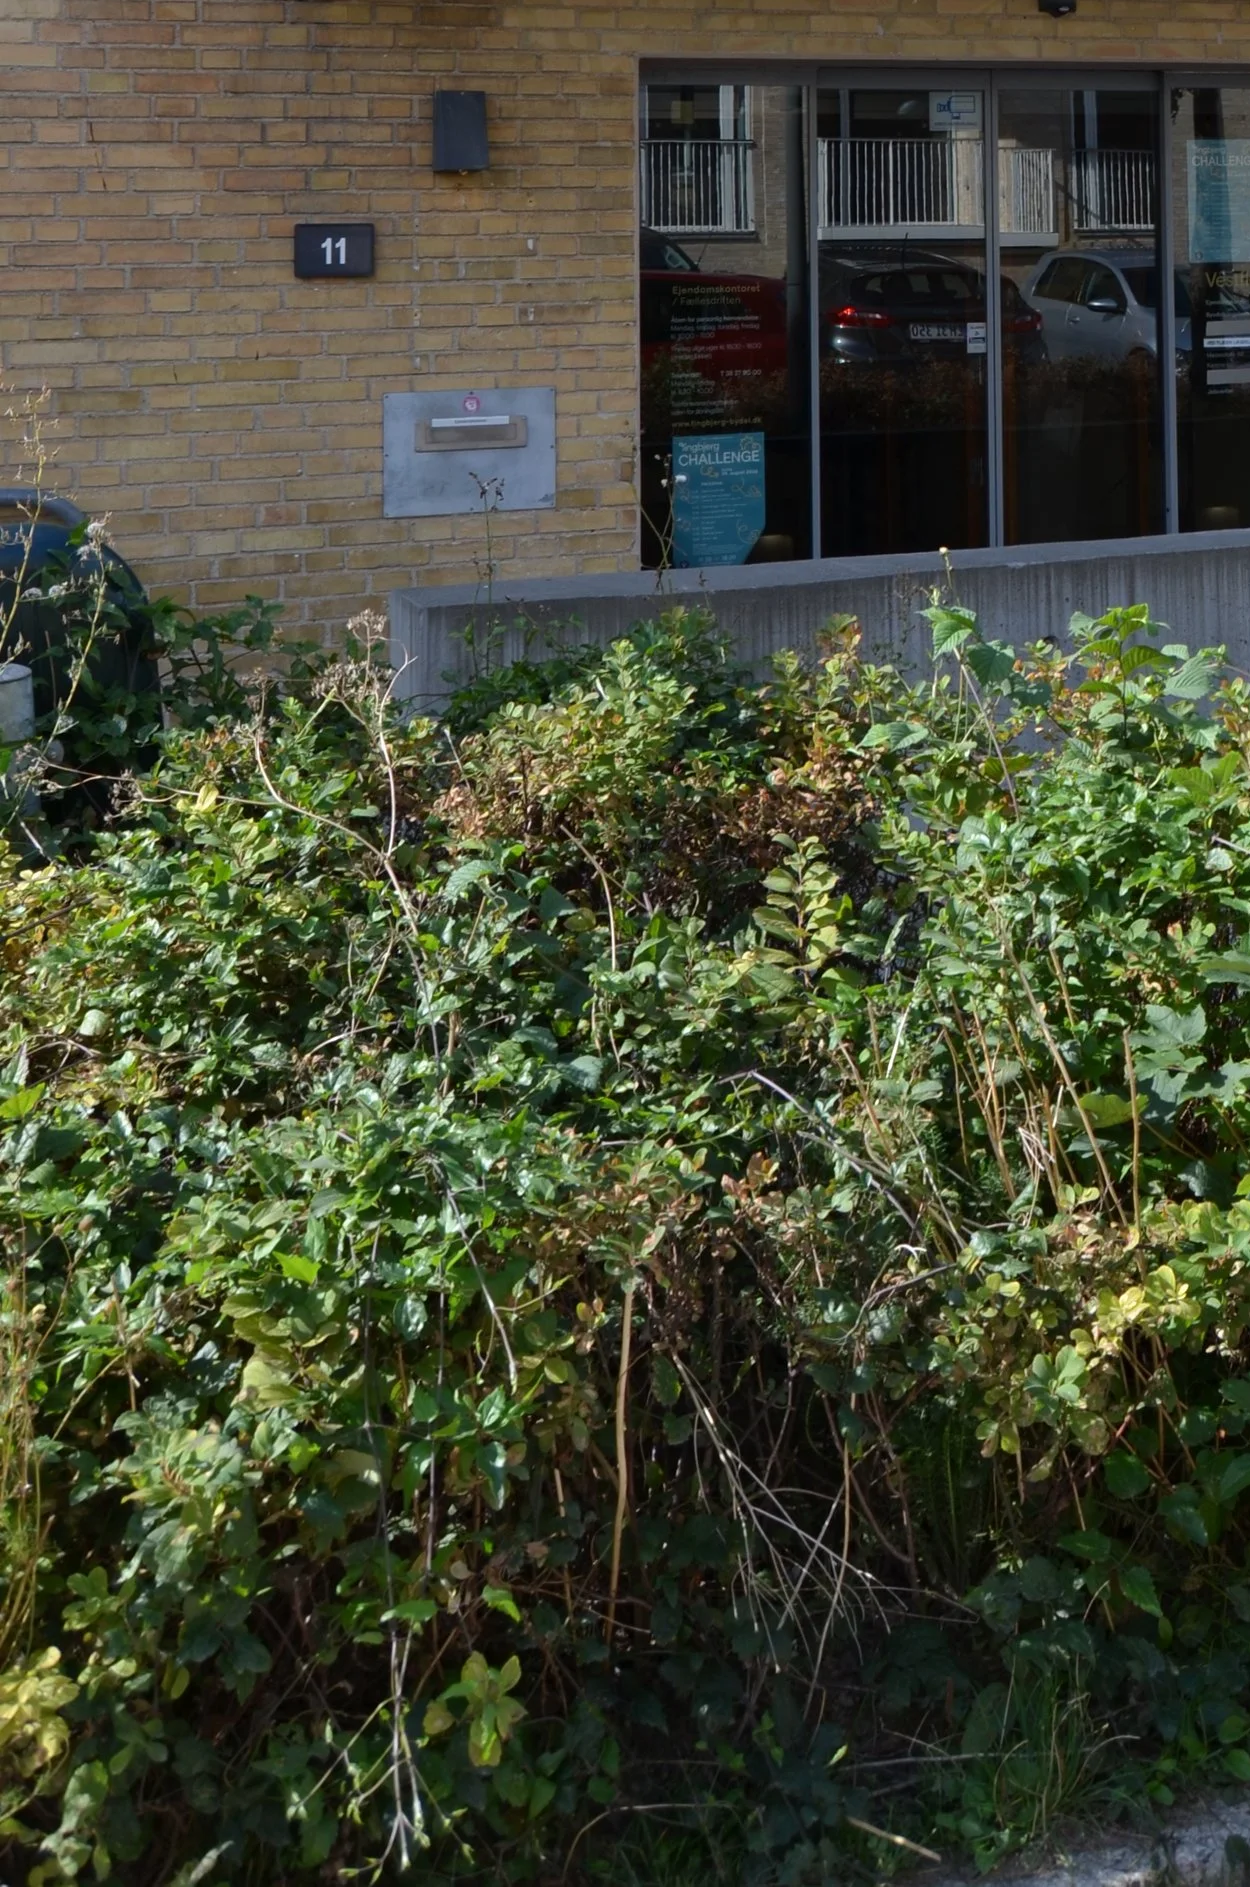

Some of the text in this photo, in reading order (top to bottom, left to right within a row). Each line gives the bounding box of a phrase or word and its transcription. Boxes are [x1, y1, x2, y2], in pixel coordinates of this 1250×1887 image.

[321, 237, 346, 265] 11
[672, 282, 761, 296] Ejendomskontoret
[678, 450, 761, 467] CHALLENGE
